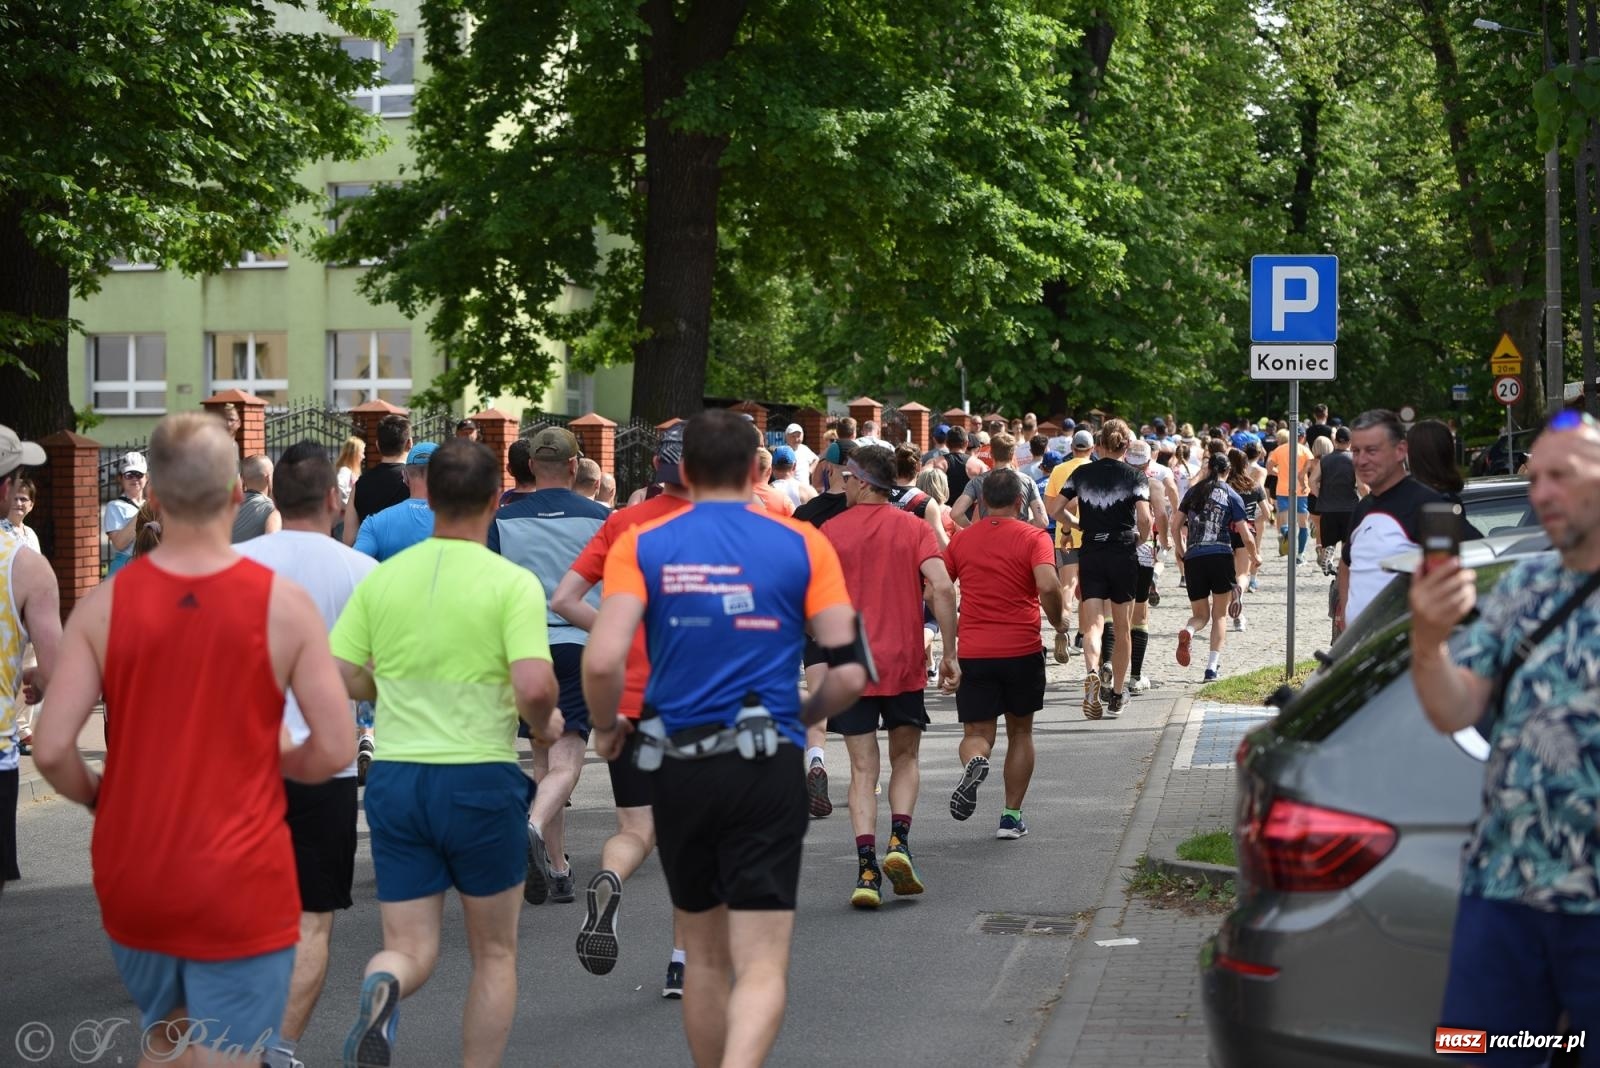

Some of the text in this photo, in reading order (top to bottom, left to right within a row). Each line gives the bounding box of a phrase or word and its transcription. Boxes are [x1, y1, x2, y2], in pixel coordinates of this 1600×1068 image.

[1271, 265, 1319, 332] P
[1257, 353, 1329, 371] Koniec
[1499, 382, 1519, 397] 20
